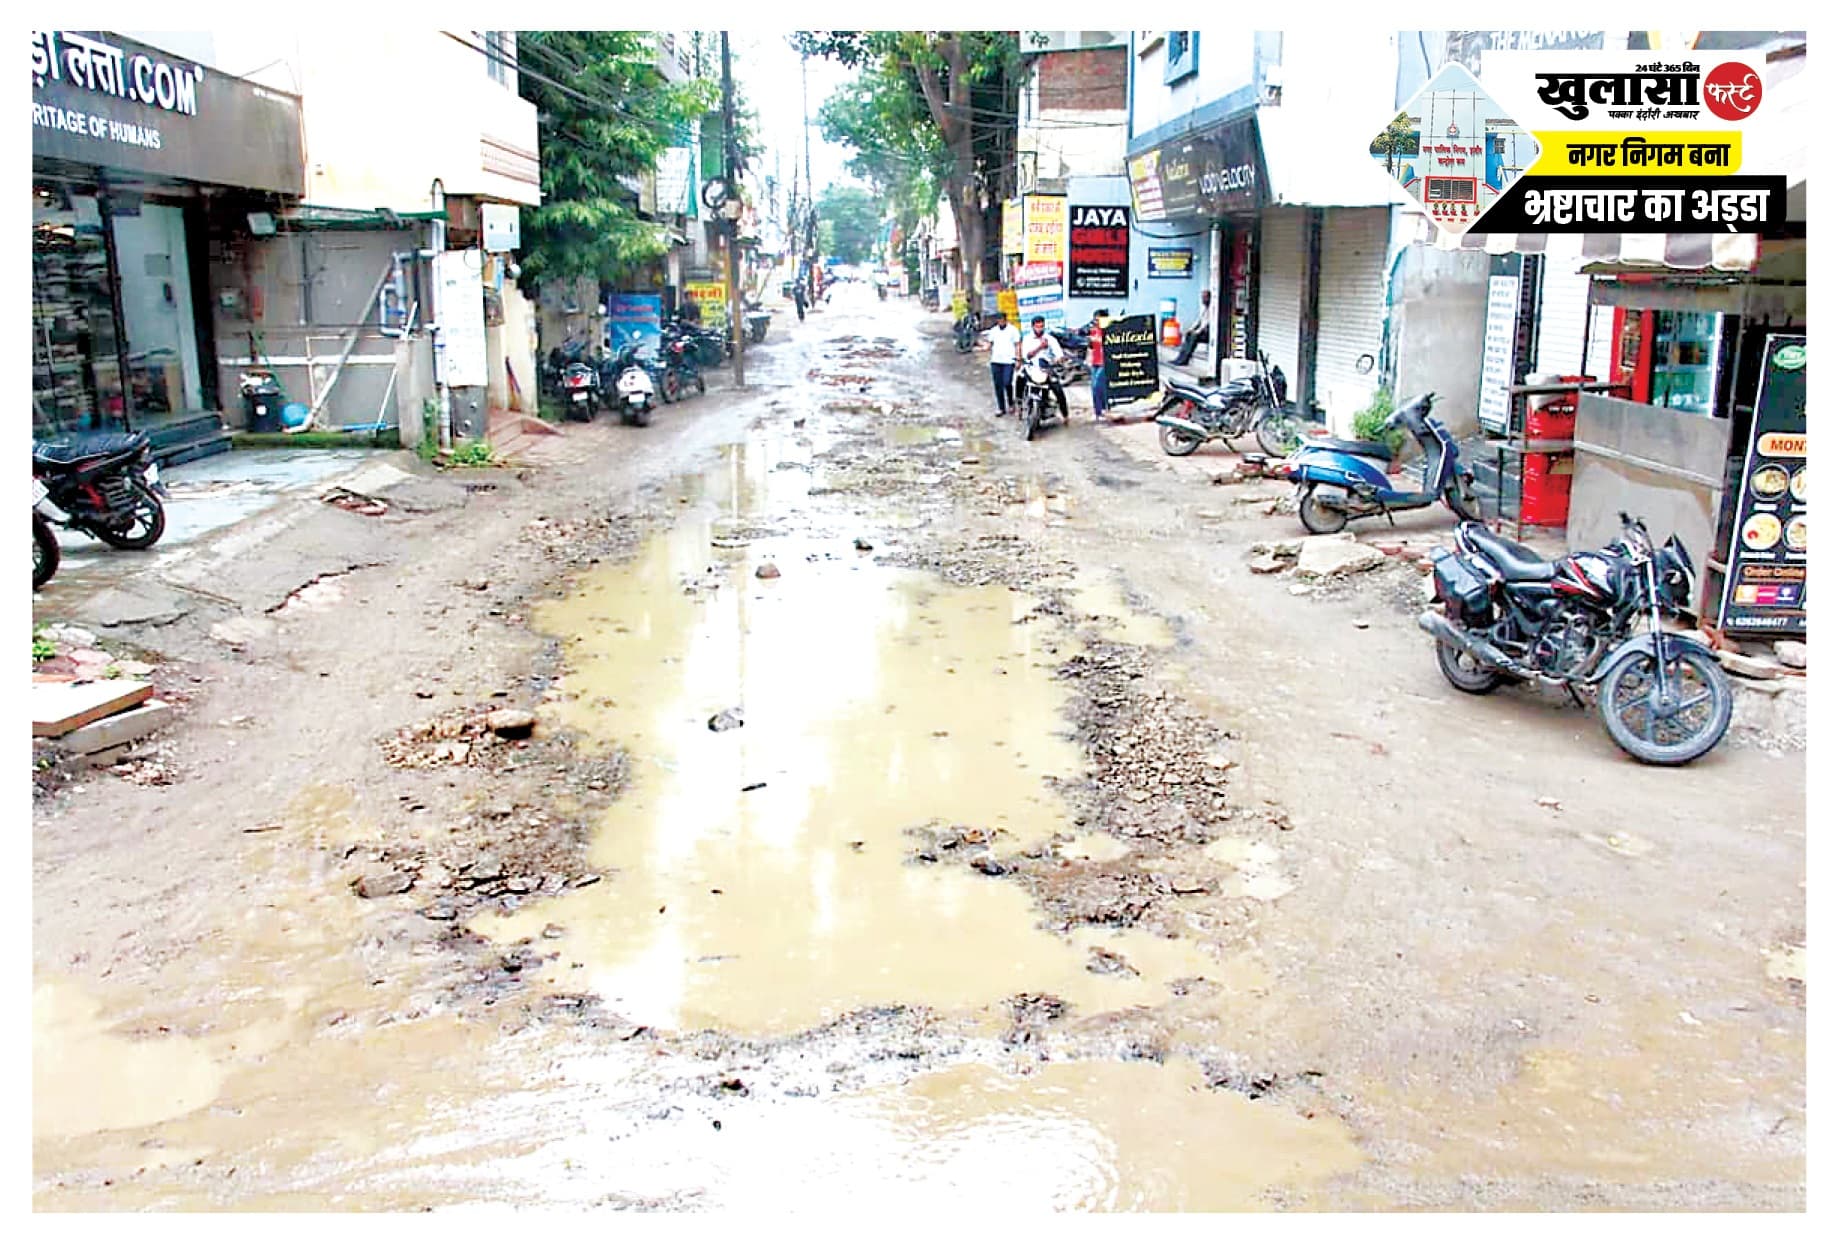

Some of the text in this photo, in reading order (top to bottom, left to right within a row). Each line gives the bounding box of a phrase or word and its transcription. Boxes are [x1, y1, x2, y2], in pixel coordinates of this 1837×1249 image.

[89, 114, 108, 139] OF
[109, 119, 161, 150] HUMANS
[1073, 208, 1127, 226] JAYA
[1770, 440, 1806, 451] MON
